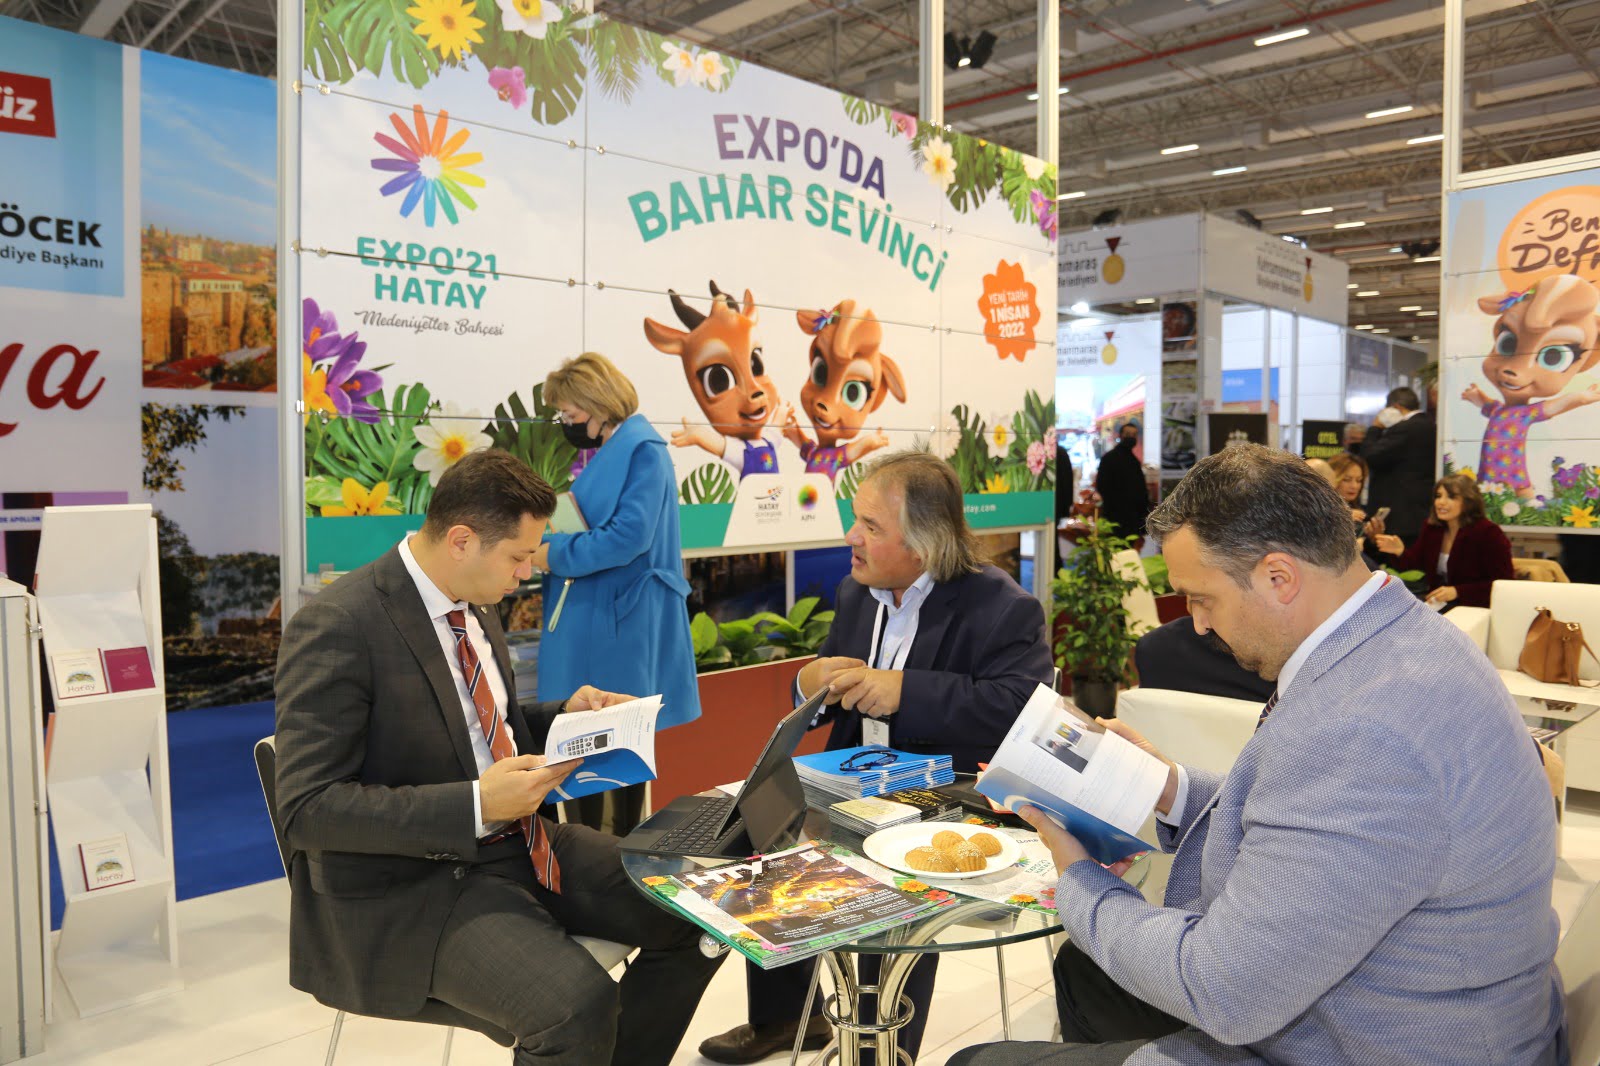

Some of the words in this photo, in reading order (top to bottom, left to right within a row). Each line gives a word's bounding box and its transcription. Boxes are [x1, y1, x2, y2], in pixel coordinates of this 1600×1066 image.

[713, 113, 886, 200] EXPO'DA
[0, 202, 102, 248] ÖCEK
[627, 172, 794, 243] BAHAR
[804, 182, 949, 292] SEVİNCİ
[1537, 208, 1600, 242] Ben
[41, 250, 104, 269] Başkanı
[356, 236, 500, 281] EXPO'21
[374, 273, 487, 310] HATAY
[454, 318, 505, 337] Bahçesi
[990, 308, 997, 323] 1
[996, 303, 1030, 322] NİSAN
[998, 321, 1025, 338] 2022
[1317, 432, 1339, 444] OTEL
